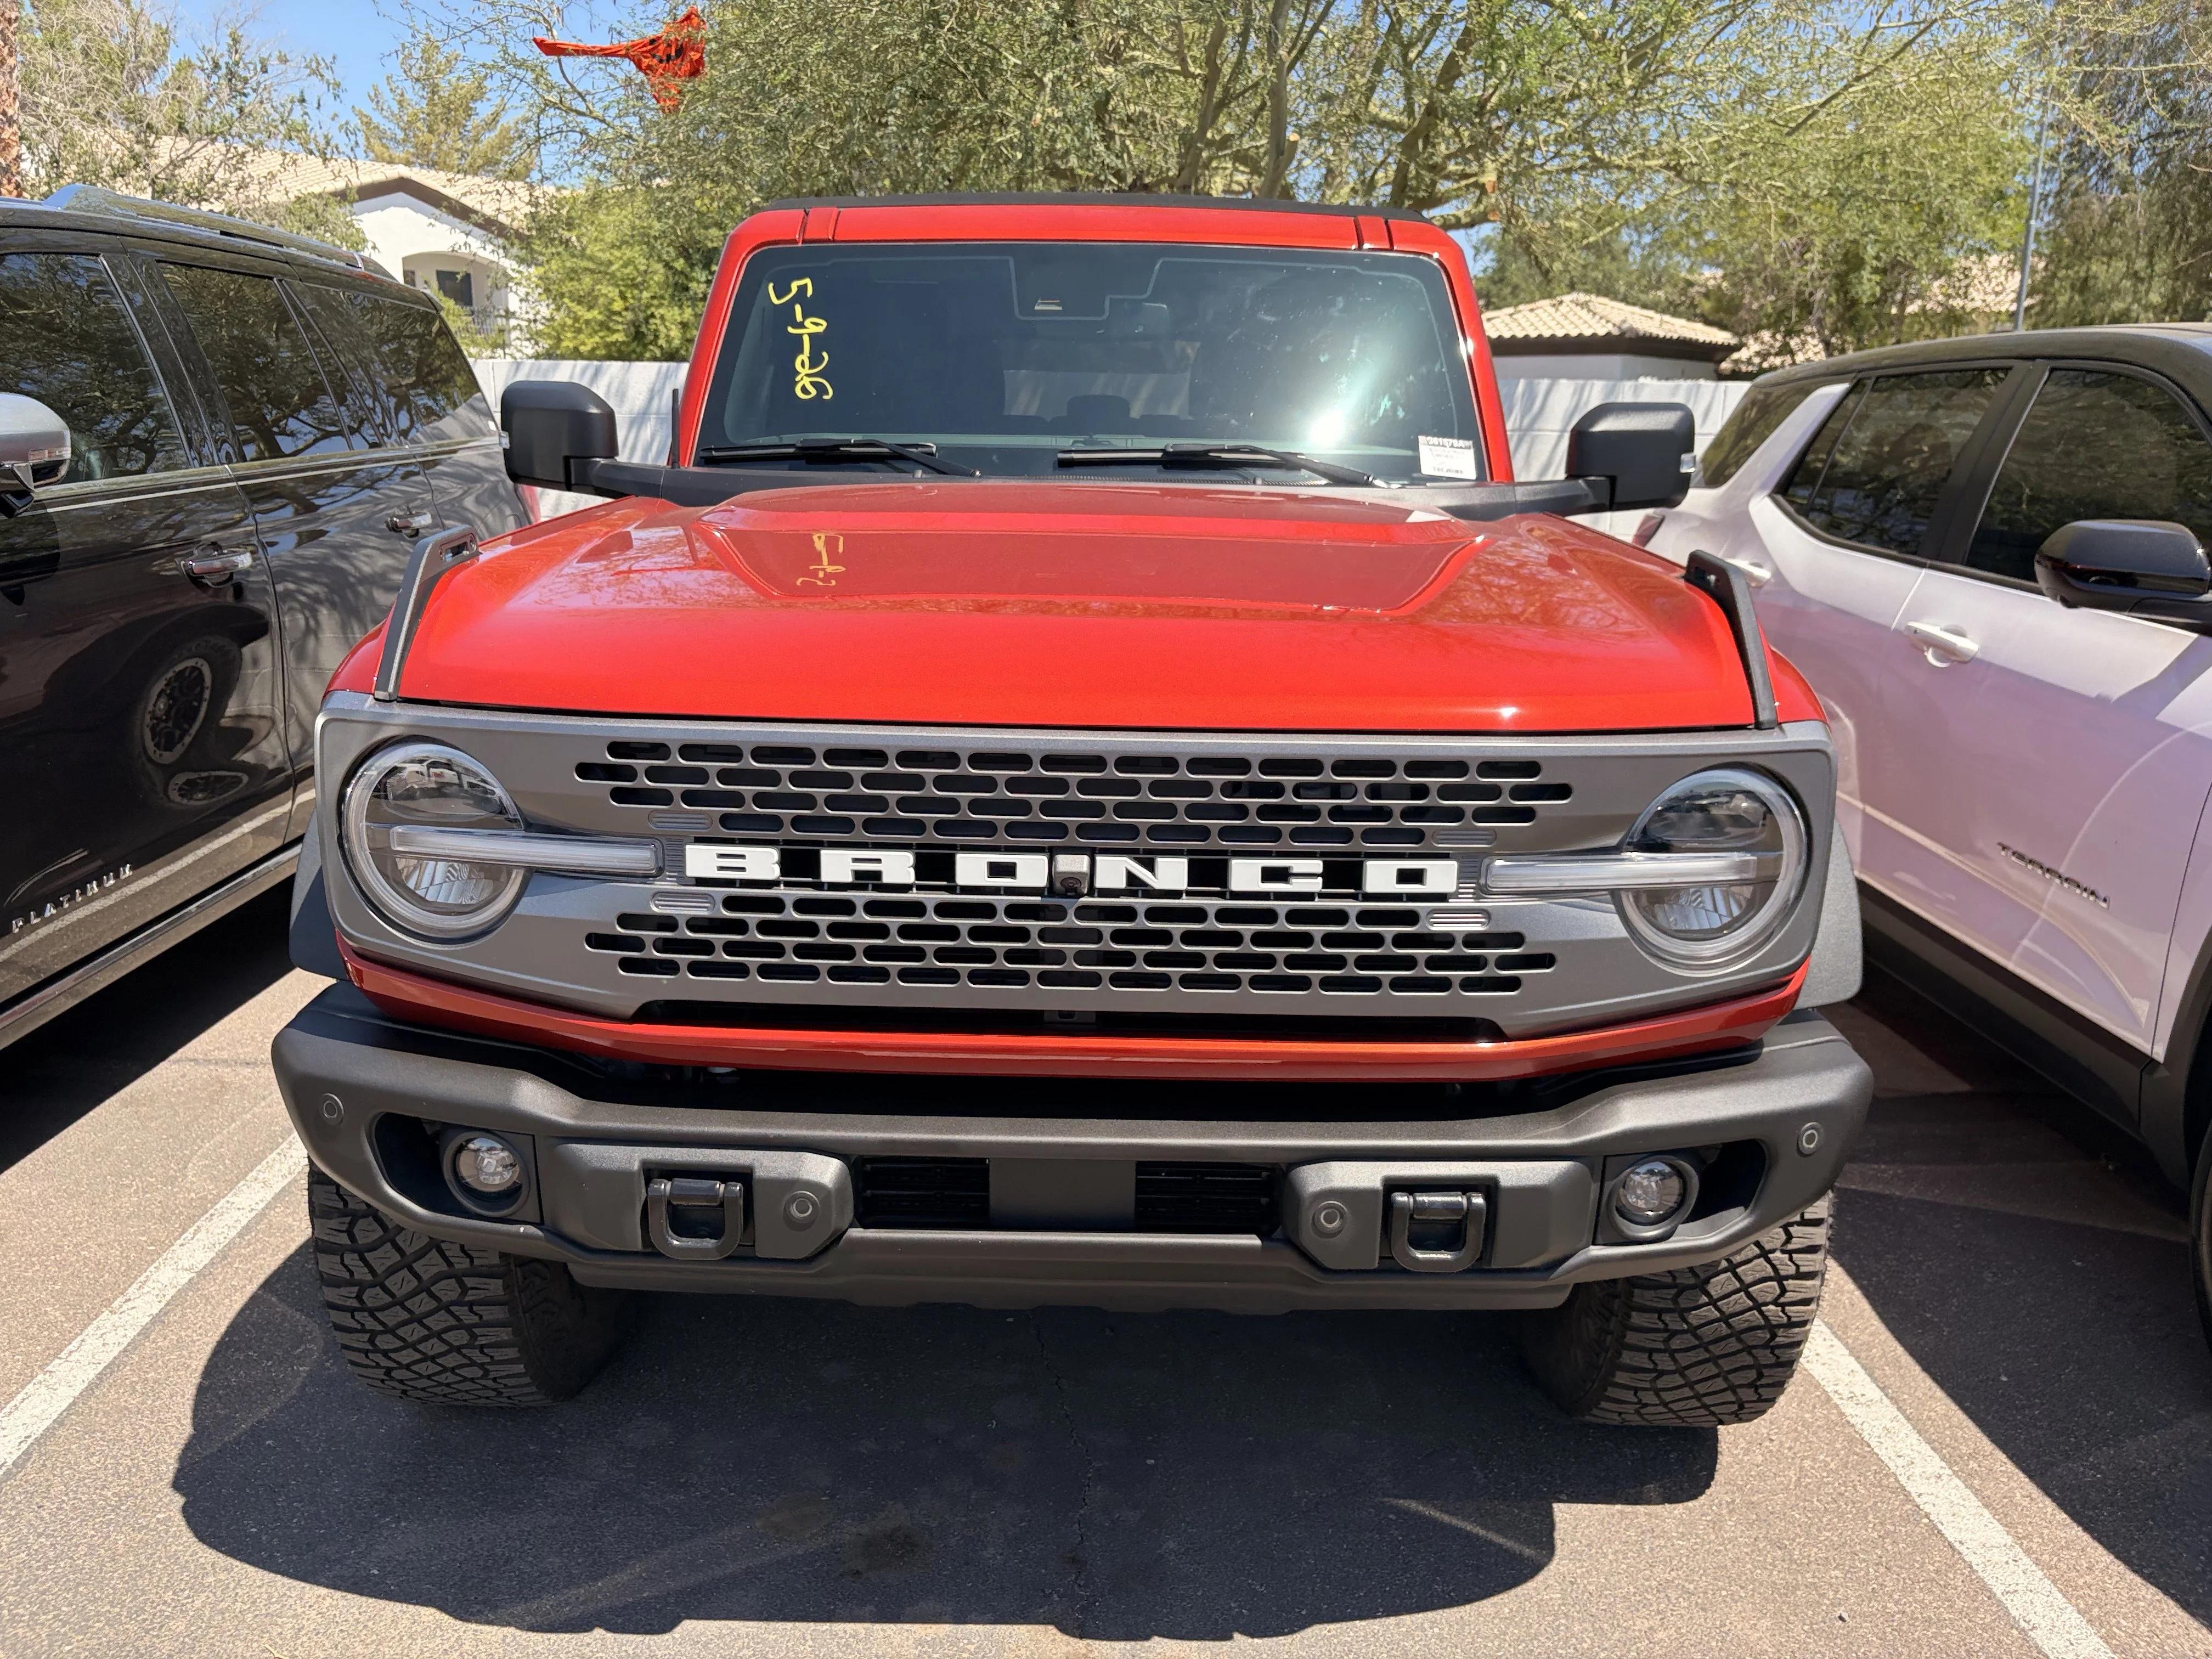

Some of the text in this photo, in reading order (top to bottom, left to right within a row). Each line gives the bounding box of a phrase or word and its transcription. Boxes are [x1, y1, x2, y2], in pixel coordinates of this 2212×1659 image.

[768, 277, 833, 400] 5-9-26
[11, 864, 134, 934] PLATINUM
[684, 844, 1459, 894] BRONCO
